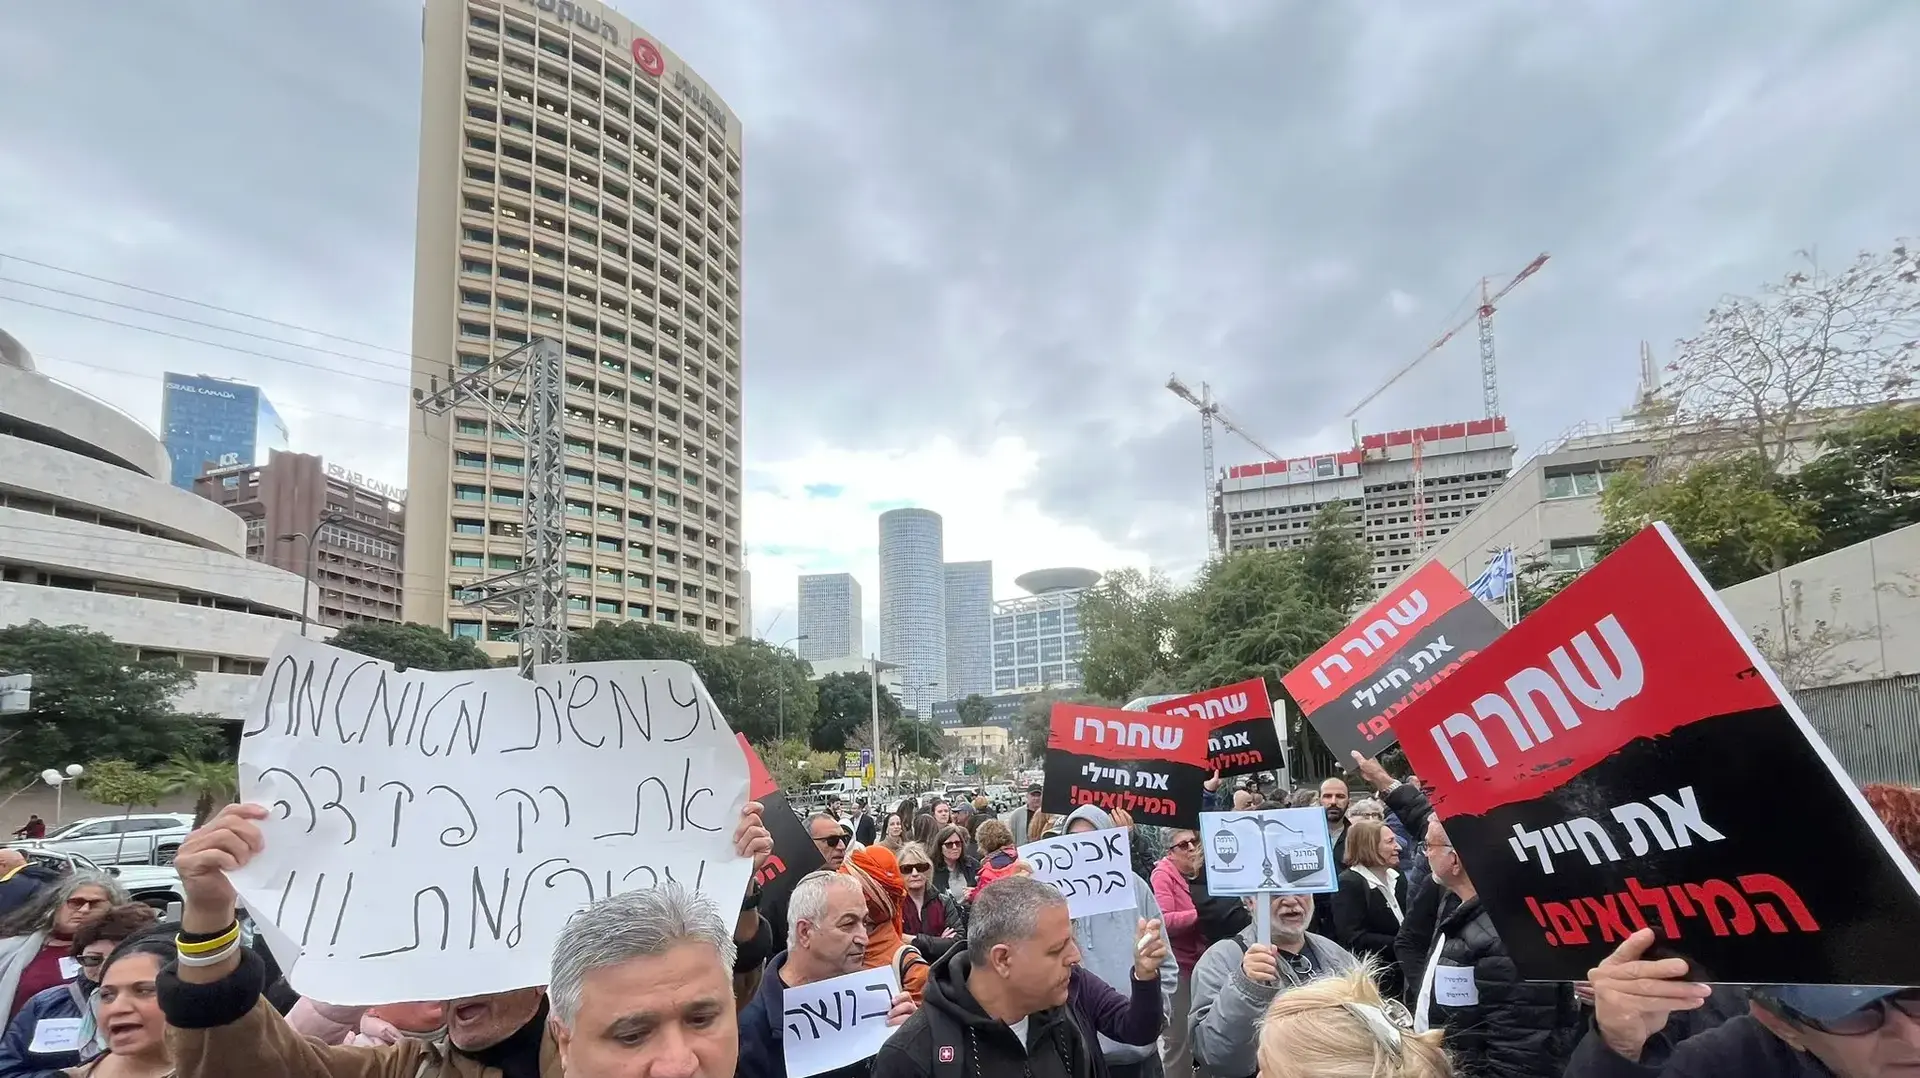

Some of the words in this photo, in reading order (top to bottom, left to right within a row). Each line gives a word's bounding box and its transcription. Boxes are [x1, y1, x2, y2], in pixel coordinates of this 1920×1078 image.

[166, 382, 196, 393] ISRAEL
[198, 387, 236, 400] CANADA
[328, 462, 366, 487] ISRAEL
[1311, 589, 1428, 690] שחררו
[1408, 634, 1455, 673] את
[243, 655, 487, 757] מטומטמת
[1351, 668, 1412, 710] חיילי
[1429, 613, 1644, 783] שחררו
[1074, 716, 1184, 751] שחררו
[1222, 731, 1251, 750] את
[1082, 762, 1131, 784] חיילי
[1135, 770, 1170, 791] את
[258, 767, 478, 847] פקידה
[495, 786, 569, 854] רק
[594, 758, 721, 840] את
[1070, 785, 1176, 817] המילואים!
[1610, 786, 1727, 858] את
[1026, 833, 1124, 874] אכיפה
[1508, 816, 1622, 875] חיילי
[1524, 873, 1821, 947] המילואים!
[785, 983, 893, 1041] בושה
